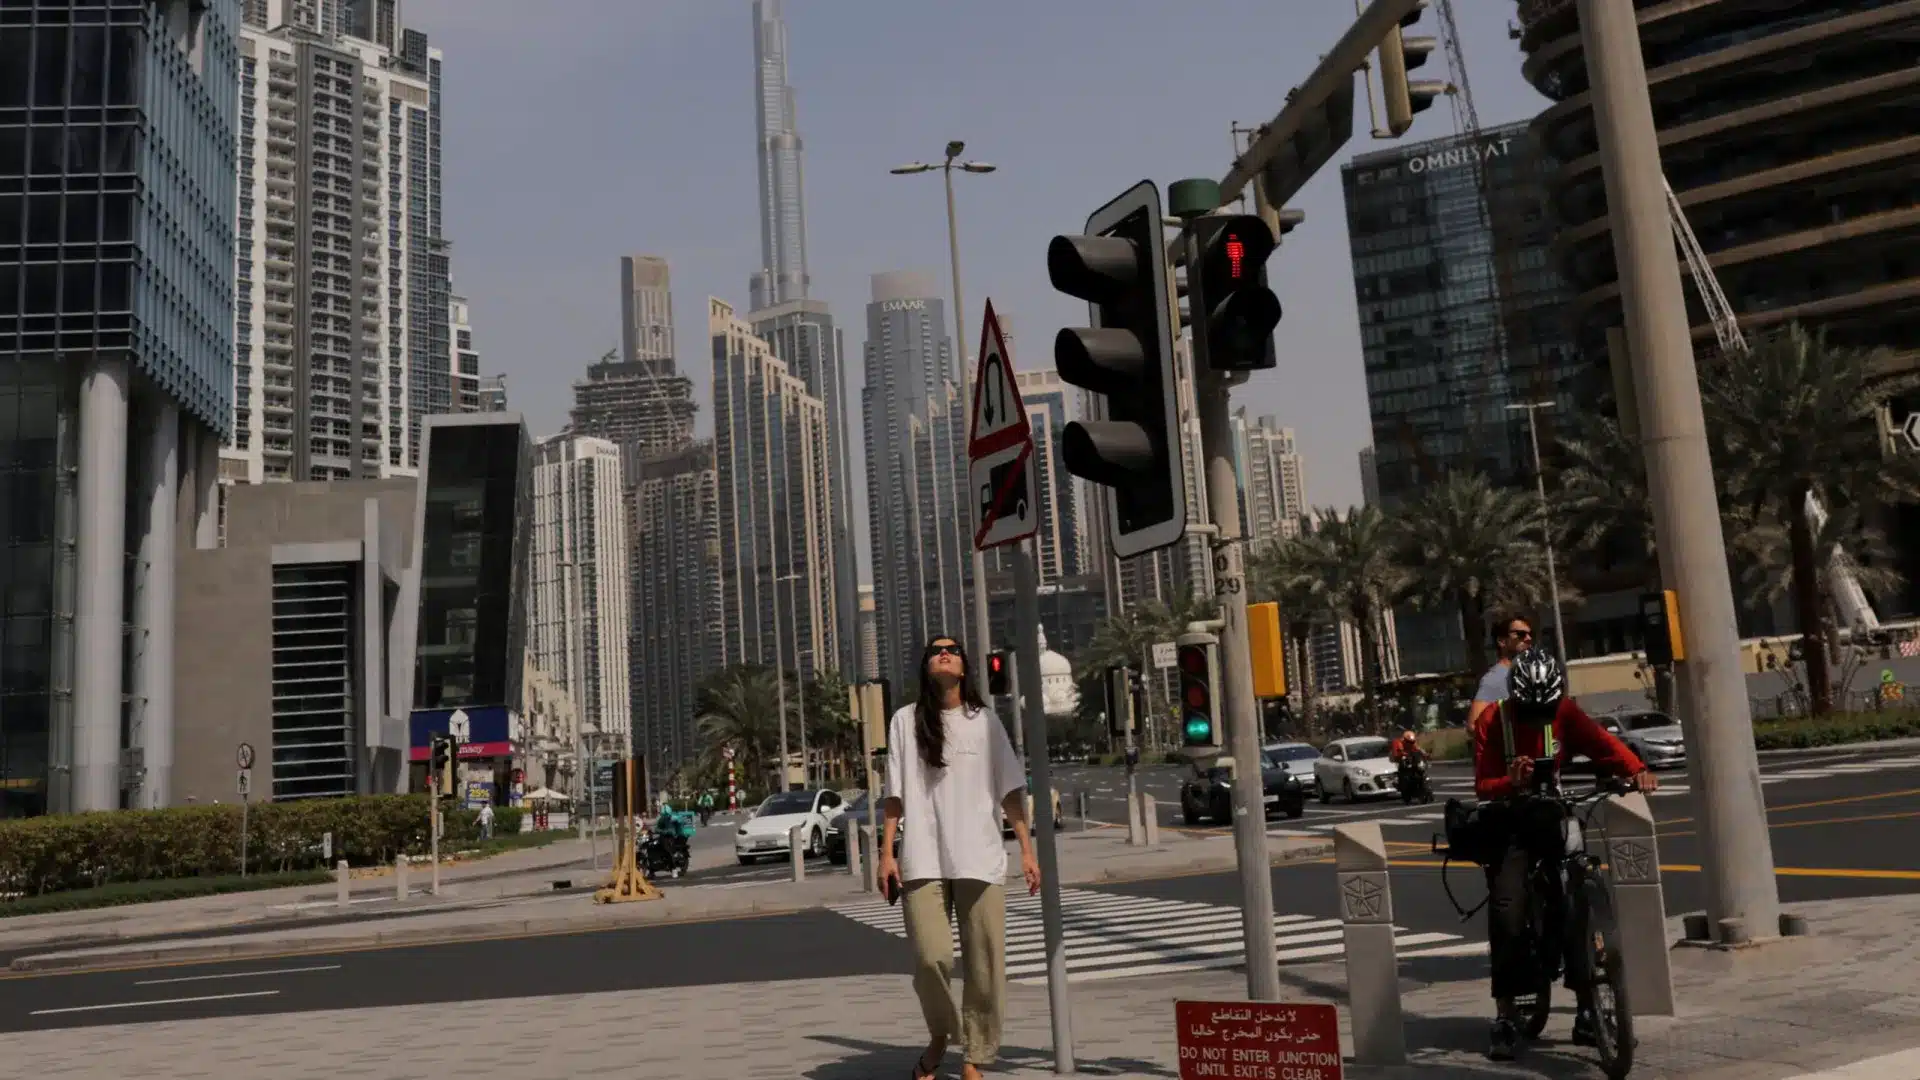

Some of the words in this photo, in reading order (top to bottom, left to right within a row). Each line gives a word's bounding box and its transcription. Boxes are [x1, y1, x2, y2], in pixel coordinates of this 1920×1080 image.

[882, 300, 926, 312] EMAAR
[1215, 577, 1240, 595] 29
[1211, 1008, 1252, 1024] التقاطع
[1222, 1026, 1262, 1042] المخرج
[1264, 1024, 1293, 1042] يكون
[1180, 1046, 1198, 1059] DO
[1202, 1047, 1227, 1060] NOT
[1232, 1049, 1270, 1063] ENTER
[1277, 1051, 1337, 1066] JUNCTION
[1196, 1064, 1228, 1077] UNTIL
[1264, 1066, 1276, 1080] IS
[1281, 1067, 1322, 1080] CLEAR
